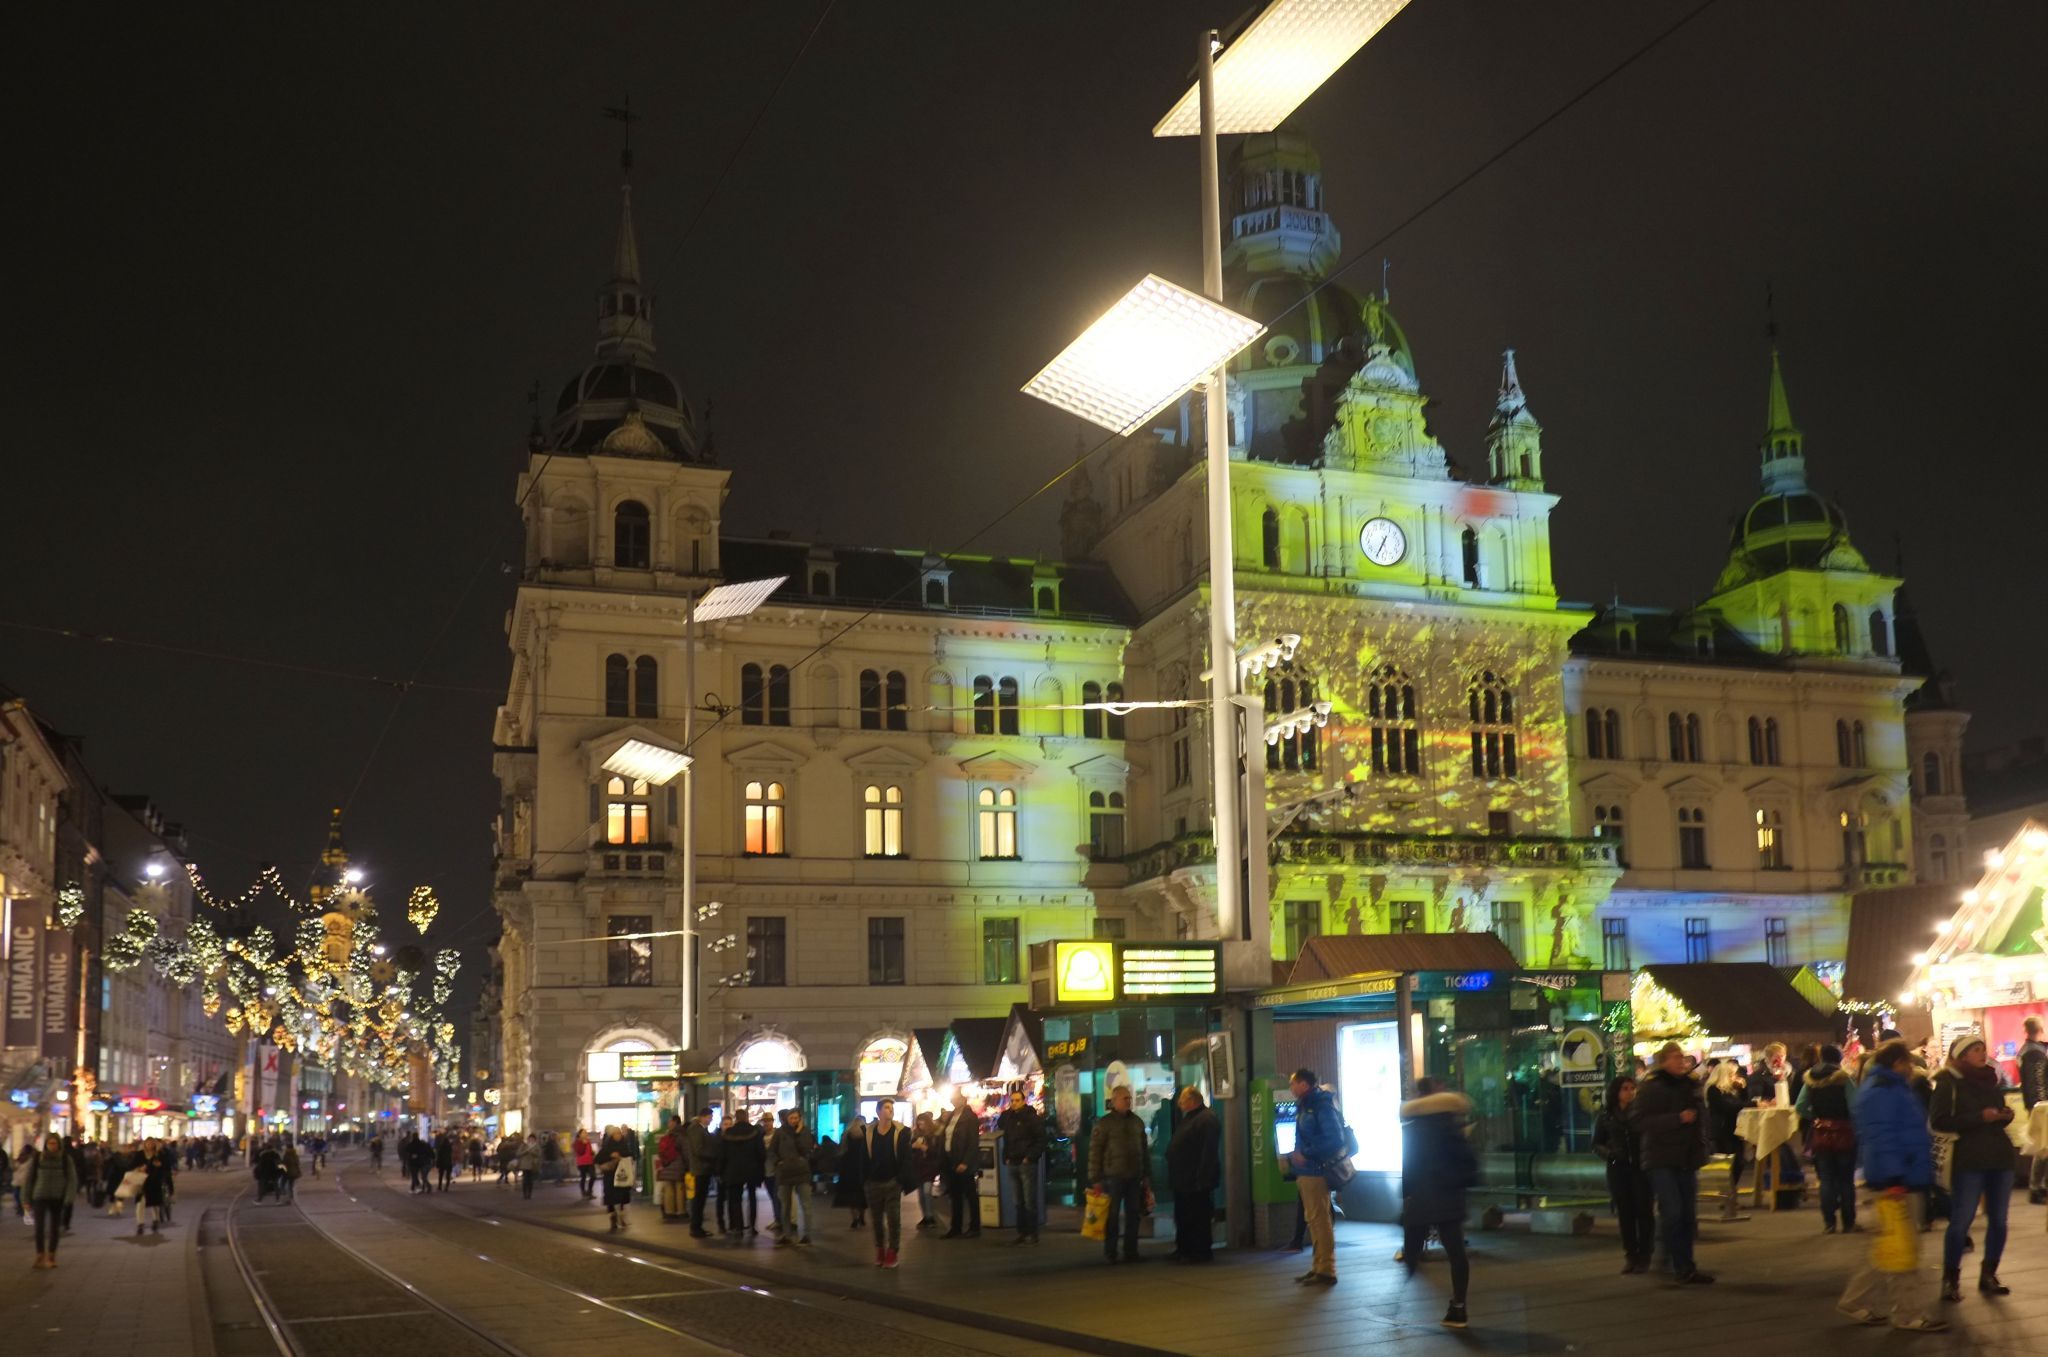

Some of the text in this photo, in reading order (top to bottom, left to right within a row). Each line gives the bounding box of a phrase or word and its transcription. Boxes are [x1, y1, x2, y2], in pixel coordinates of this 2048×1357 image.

[11, 926, 35, 1019] HUMANIC
[1360, 979, 1395, 993] TICKETS
[1444, 975, 1489, 988] TICKETS
[1535, 975, 1578, 988] TICKETS
[46, 953, 67, 1033] HUMANIC
[1306, 986, 1338, 1000] TICKETS
[1251, 1092, 1263, 1167] TICKETS
